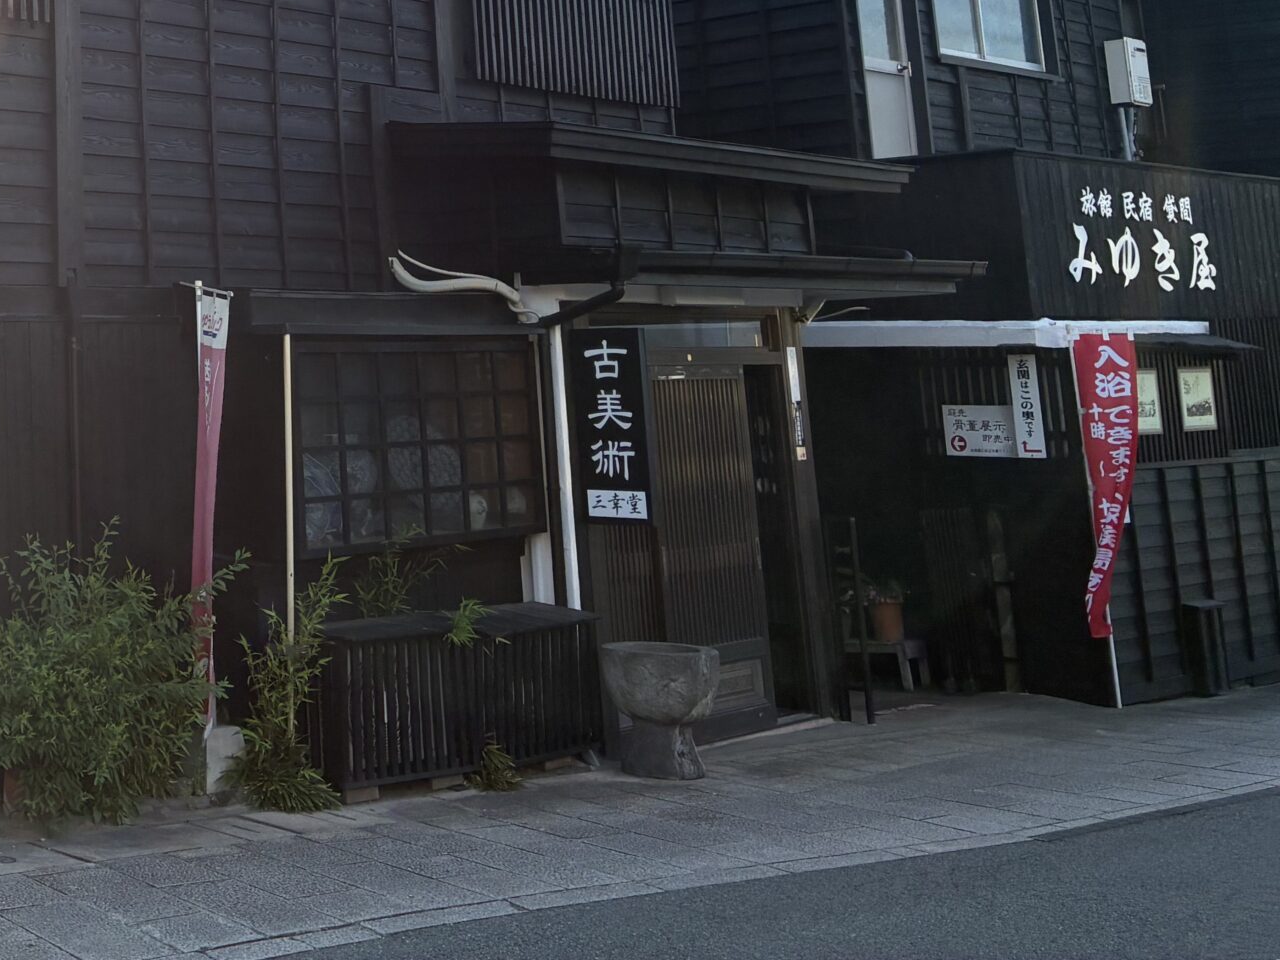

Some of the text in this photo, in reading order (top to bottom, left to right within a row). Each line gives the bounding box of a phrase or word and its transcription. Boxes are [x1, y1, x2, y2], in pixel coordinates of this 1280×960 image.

[1080, 186, 1193, 224] 旅館 民宿 貸間
[1069, 222, 1217, 292] みゆき屋
[583, 339, 635, 480] 古美術
[1094, 345, 1133, 482] 入浴できます
[591, 493, 642, 515] 三幸堂
